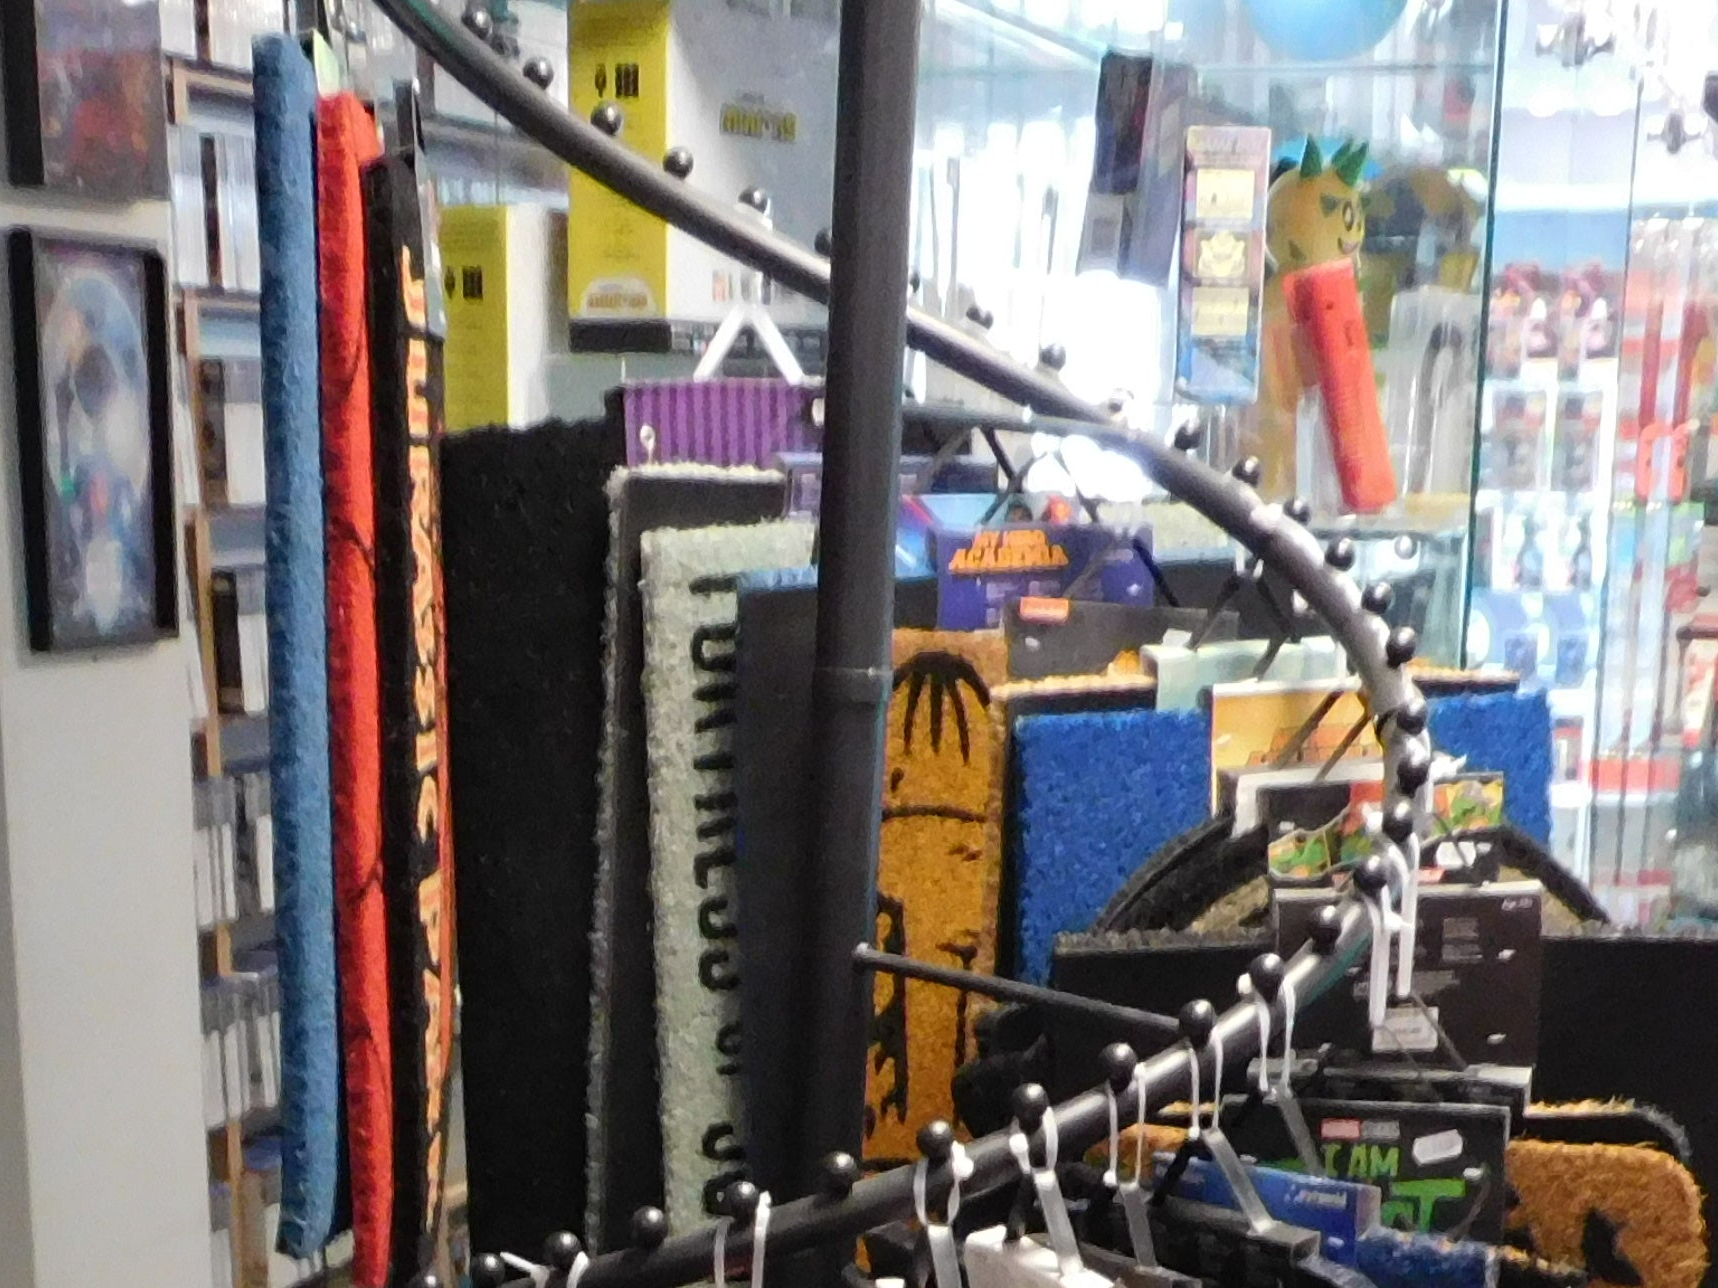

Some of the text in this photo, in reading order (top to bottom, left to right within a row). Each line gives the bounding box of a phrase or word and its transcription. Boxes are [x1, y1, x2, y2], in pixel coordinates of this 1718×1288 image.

[1002, 528, 1048, 549] HERO
[948, 544, 1070, 574] ACADEMIA
[1322, 1142, 1401, 1179] I AM
